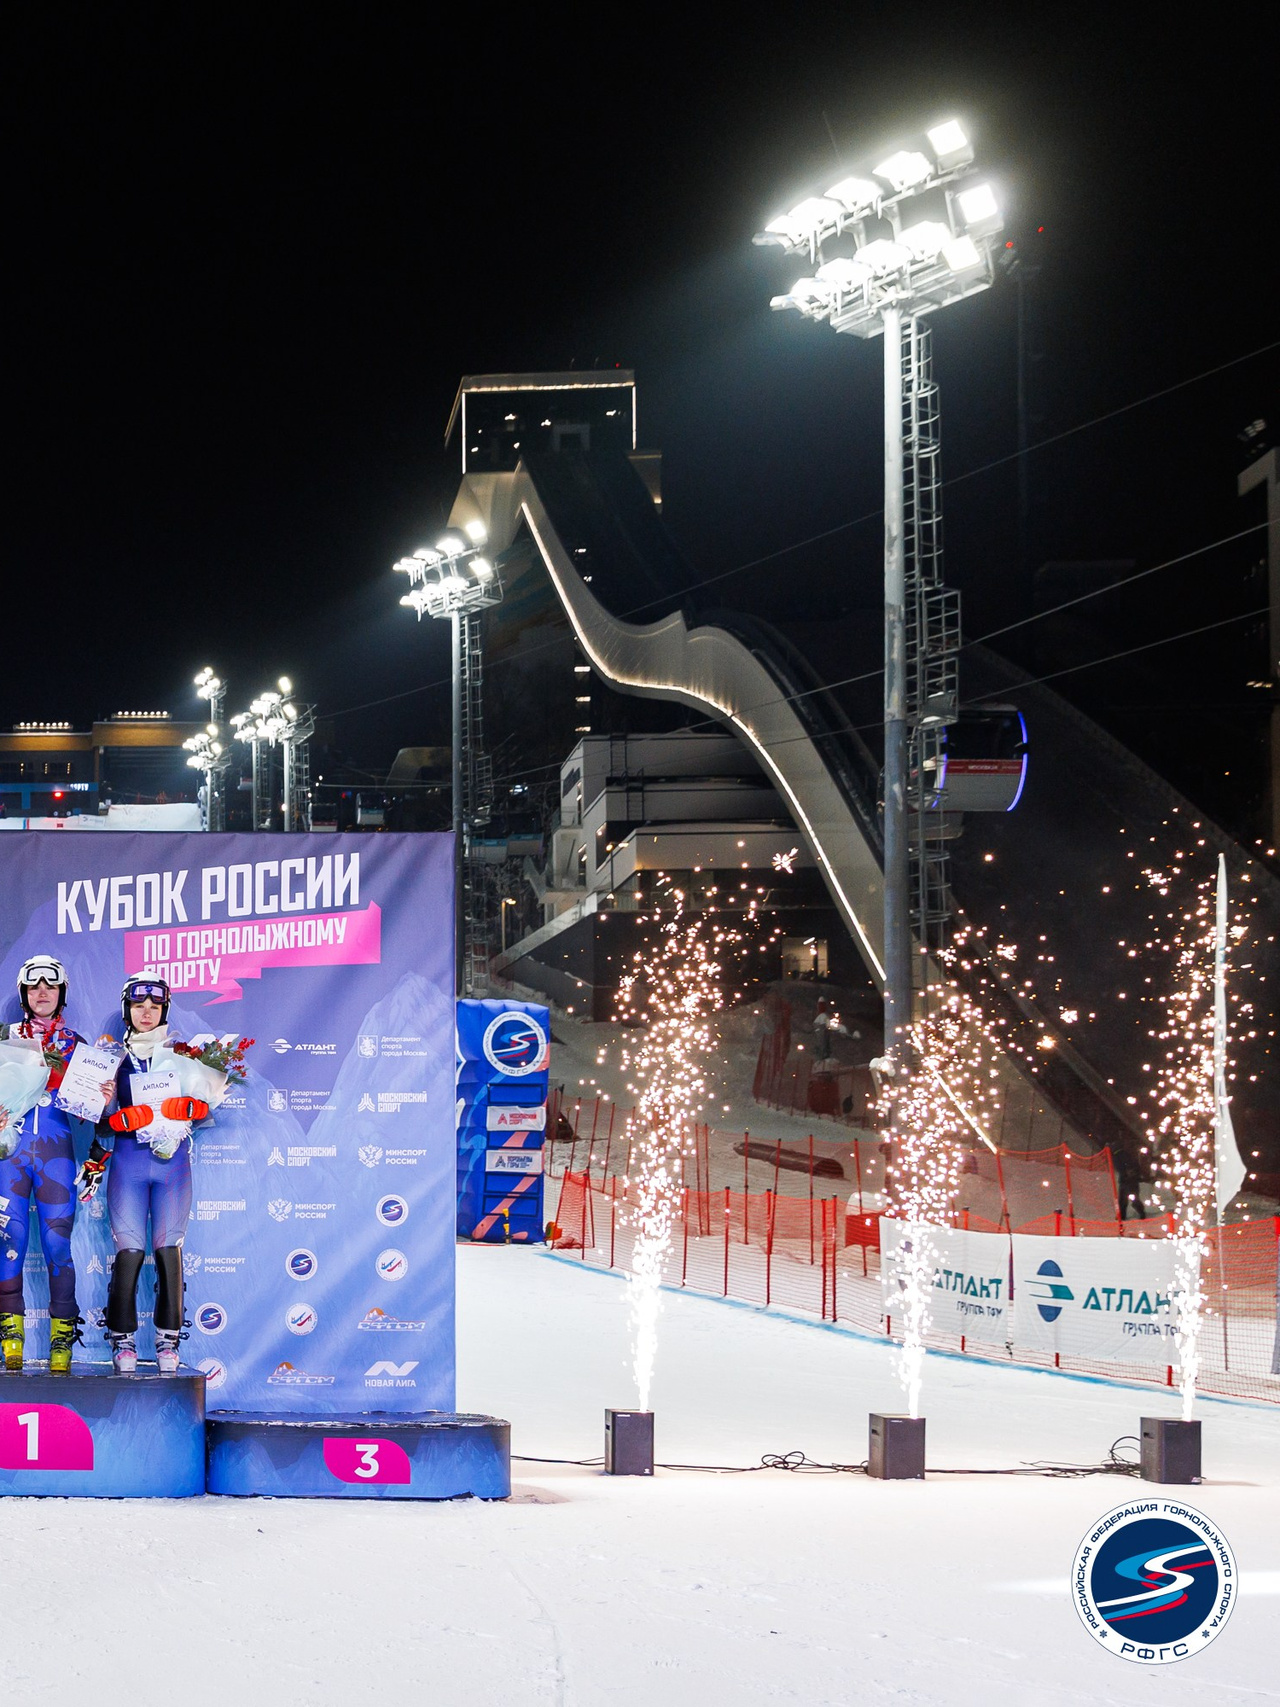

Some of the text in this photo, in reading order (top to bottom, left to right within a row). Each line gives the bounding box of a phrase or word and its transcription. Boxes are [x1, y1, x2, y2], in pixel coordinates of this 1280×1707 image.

[57, 852, 360, 934] КУБОК РОССИИ
[143, 917, 347, 962] ПО ГОРНОЛЫЖНОМУ
[82, 1058, 108, 1070] ДИПЛОМ
[142, 1082, 169, 1091] ДИПЛОМ
[378, 1091, 427, 1103] МОСКОВСКИЙ
[378, 1103, 401, 1112] СПОРТ
[287, 1145, 336, 1157] МОСКОВСКИЙ
[287, 1157, 311, 1166] СПОРТ
[197, 1199, 246, 1211] МОСКОВСКИЙ
[197, 1211, 221, 1220] СПОРТ
[931, 1268, 1002, 1299] АТЛАНТ
[1082, 1287, 1182, 1315] АТЛАН
[956, 1301, 984, 1315] ГРУППА
[1123, 1322, 1180, 1337] ГРУППА ТО
[365, 1379, 416, 1387] НОВАЯ ЛИГА
[17, 1411, 39, 1460] 1
[354, 1444, 379, 1478] 3
